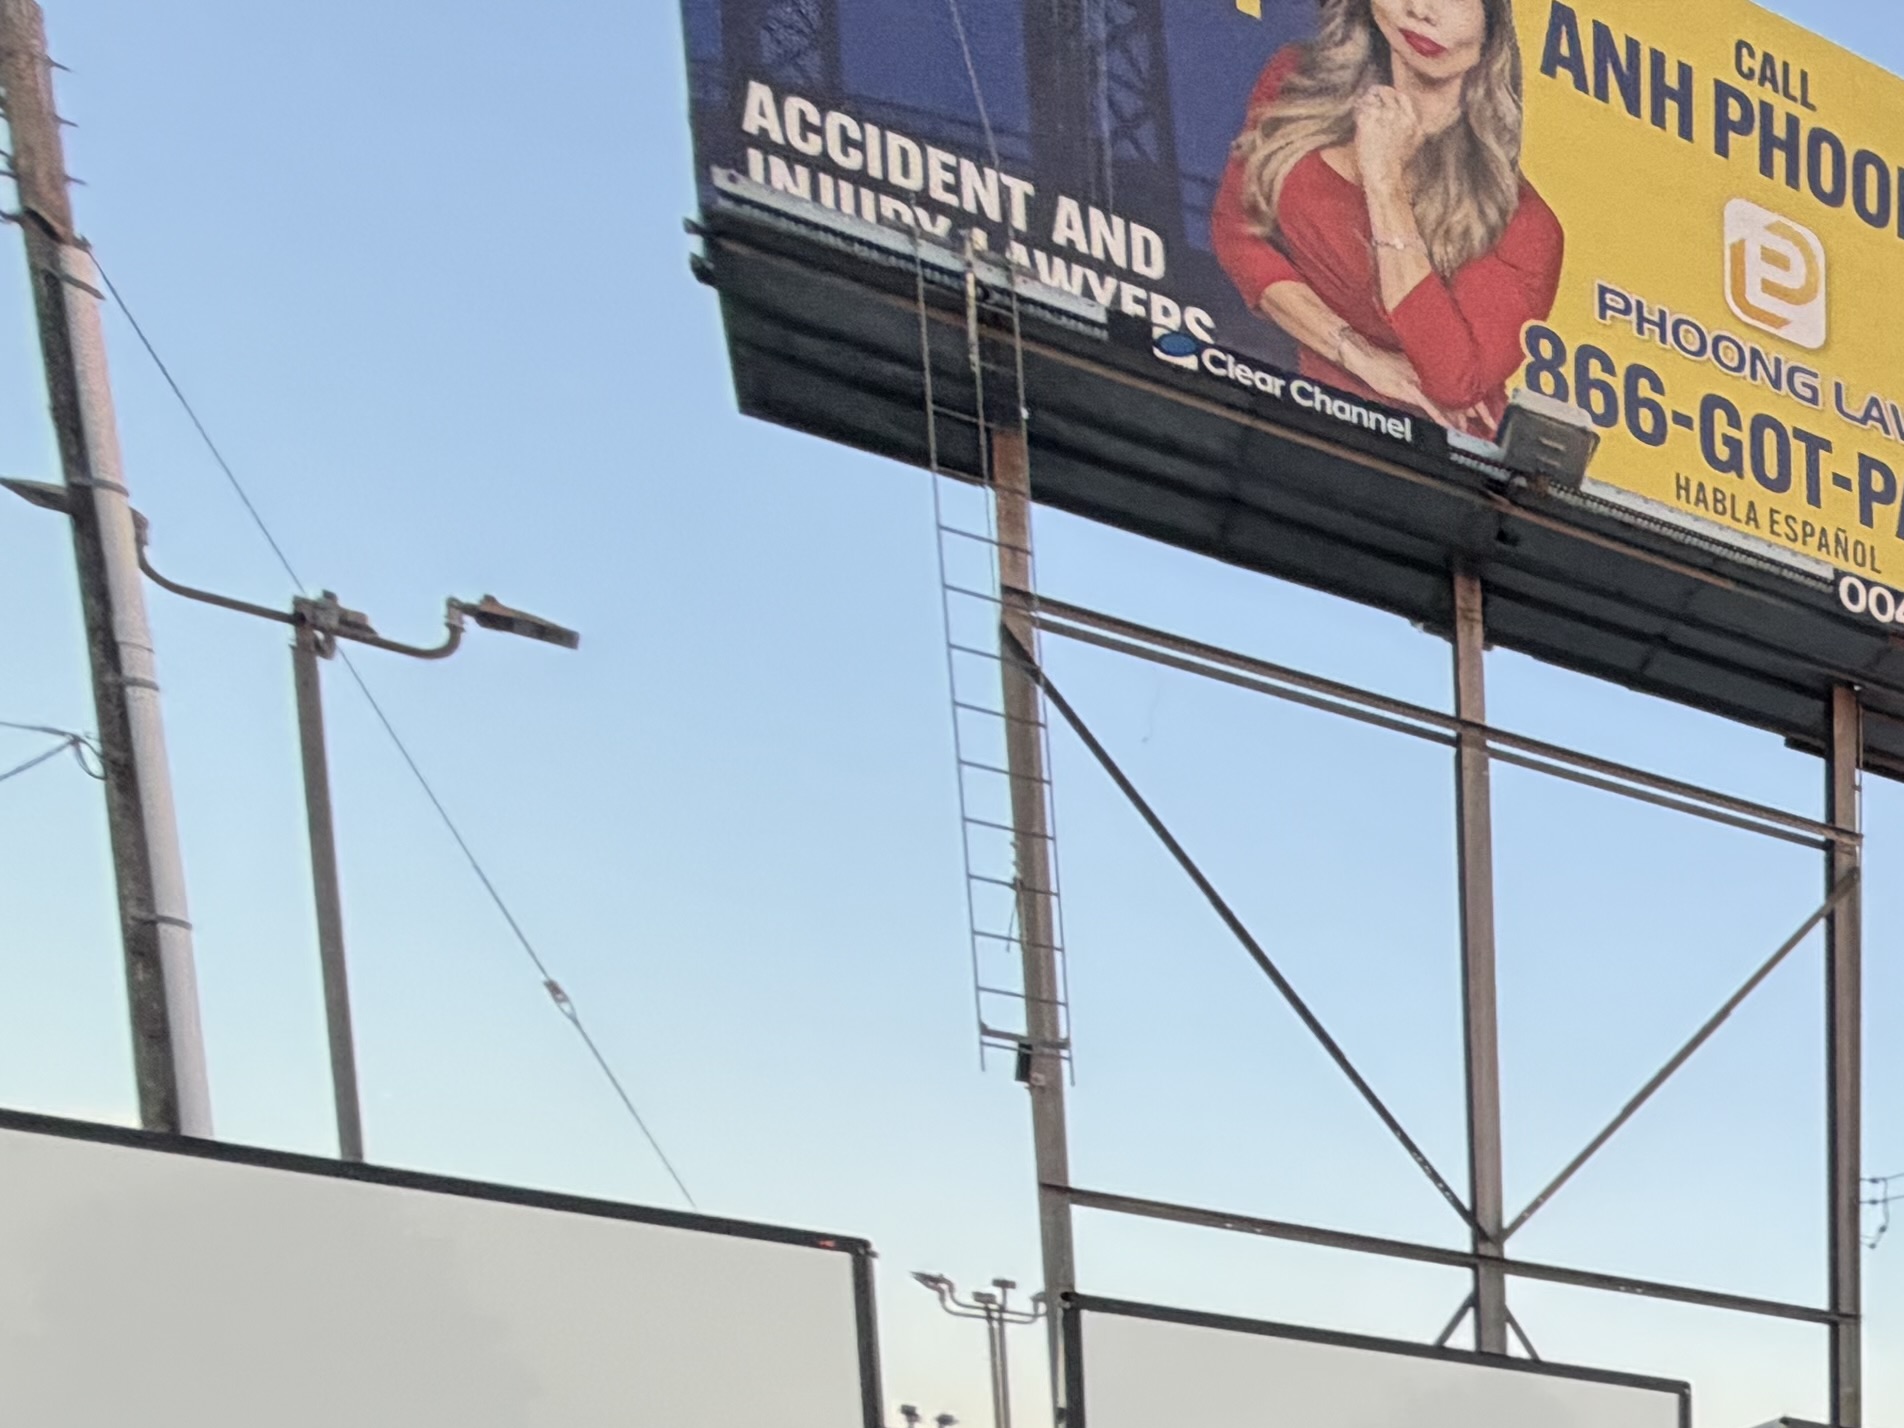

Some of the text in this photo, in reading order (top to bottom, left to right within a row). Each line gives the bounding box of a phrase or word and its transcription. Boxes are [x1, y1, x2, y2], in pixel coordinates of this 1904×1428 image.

[1540, 0, 1694, 144] ANH
[1734, 39, 1817, 112] CALL
[742, 80, 1166, 281] ACCIDENT AND
[1200, 348, 1413, 443] Clear Channel
[1597, 283, 1820, 406] PHOONG
[1675, 472, 1883, 574] HABLA ESPAÑOL
